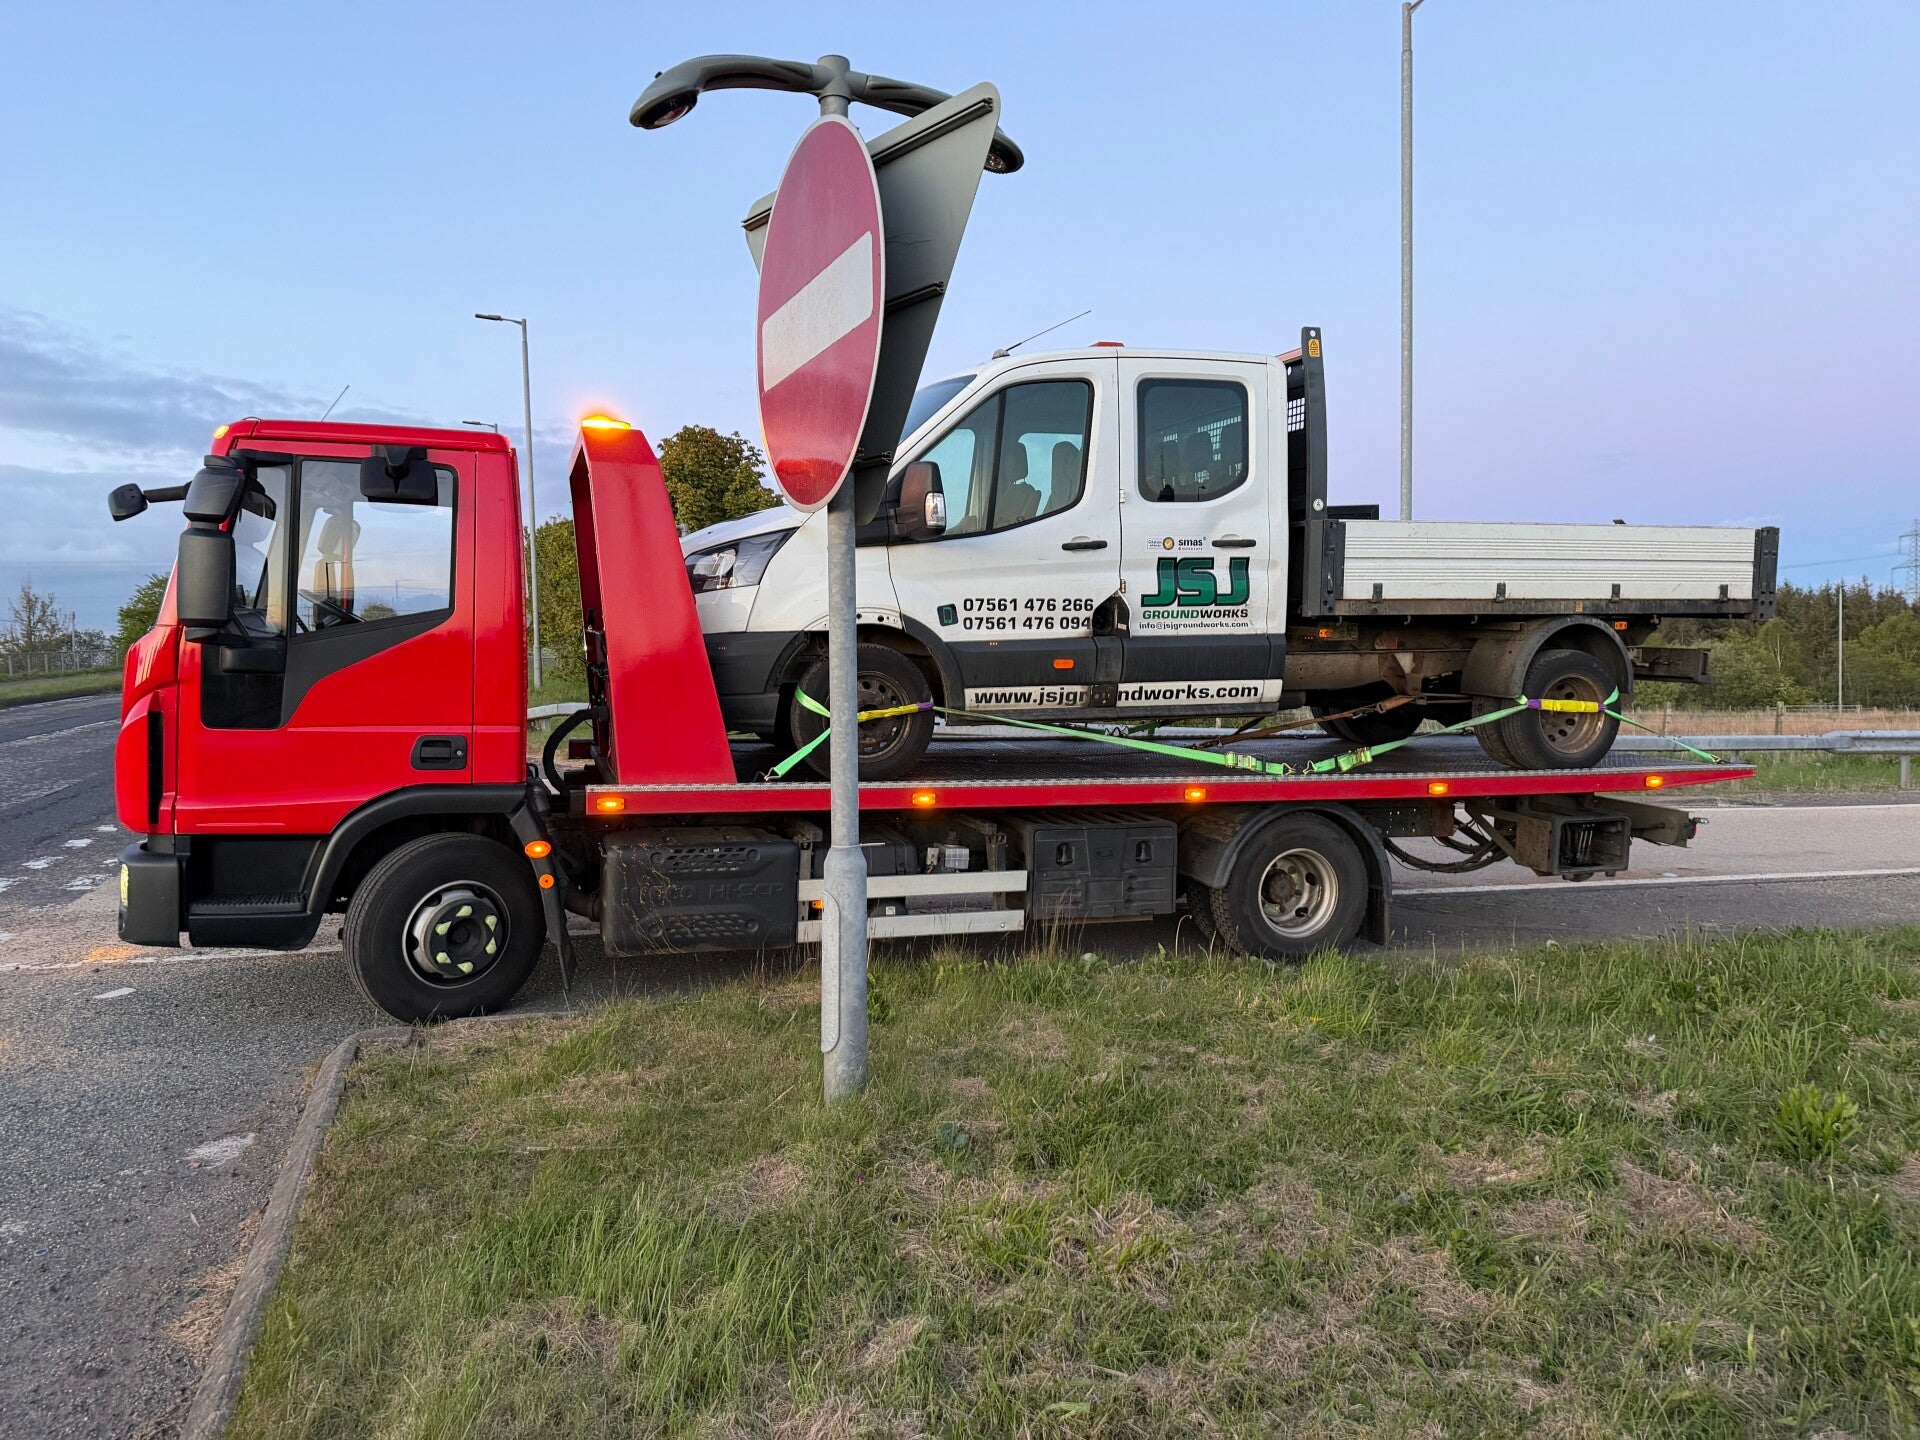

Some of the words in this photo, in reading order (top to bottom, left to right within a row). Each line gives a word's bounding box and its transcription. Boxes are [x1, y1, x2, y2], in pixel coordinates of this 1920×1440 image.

[1141, 557, 1250, 607] JSJ
[963, 598, 1018, 611] 07561
[1024, 598, 1057, 611] 476
[1062, 598, 1094, 611] 266
[1142, 609, 1248, 620] GROUNDWORKS
[963, 616, 1017, 630] 07561
[1022, 616, 1055, 630] 476
[1060, 616, 1092, 630] 094
[1139, 621, 1249, 631] info@jsjgroundworks.com
[974, 684, 1258, 706] www.jsjgrndworks.com
